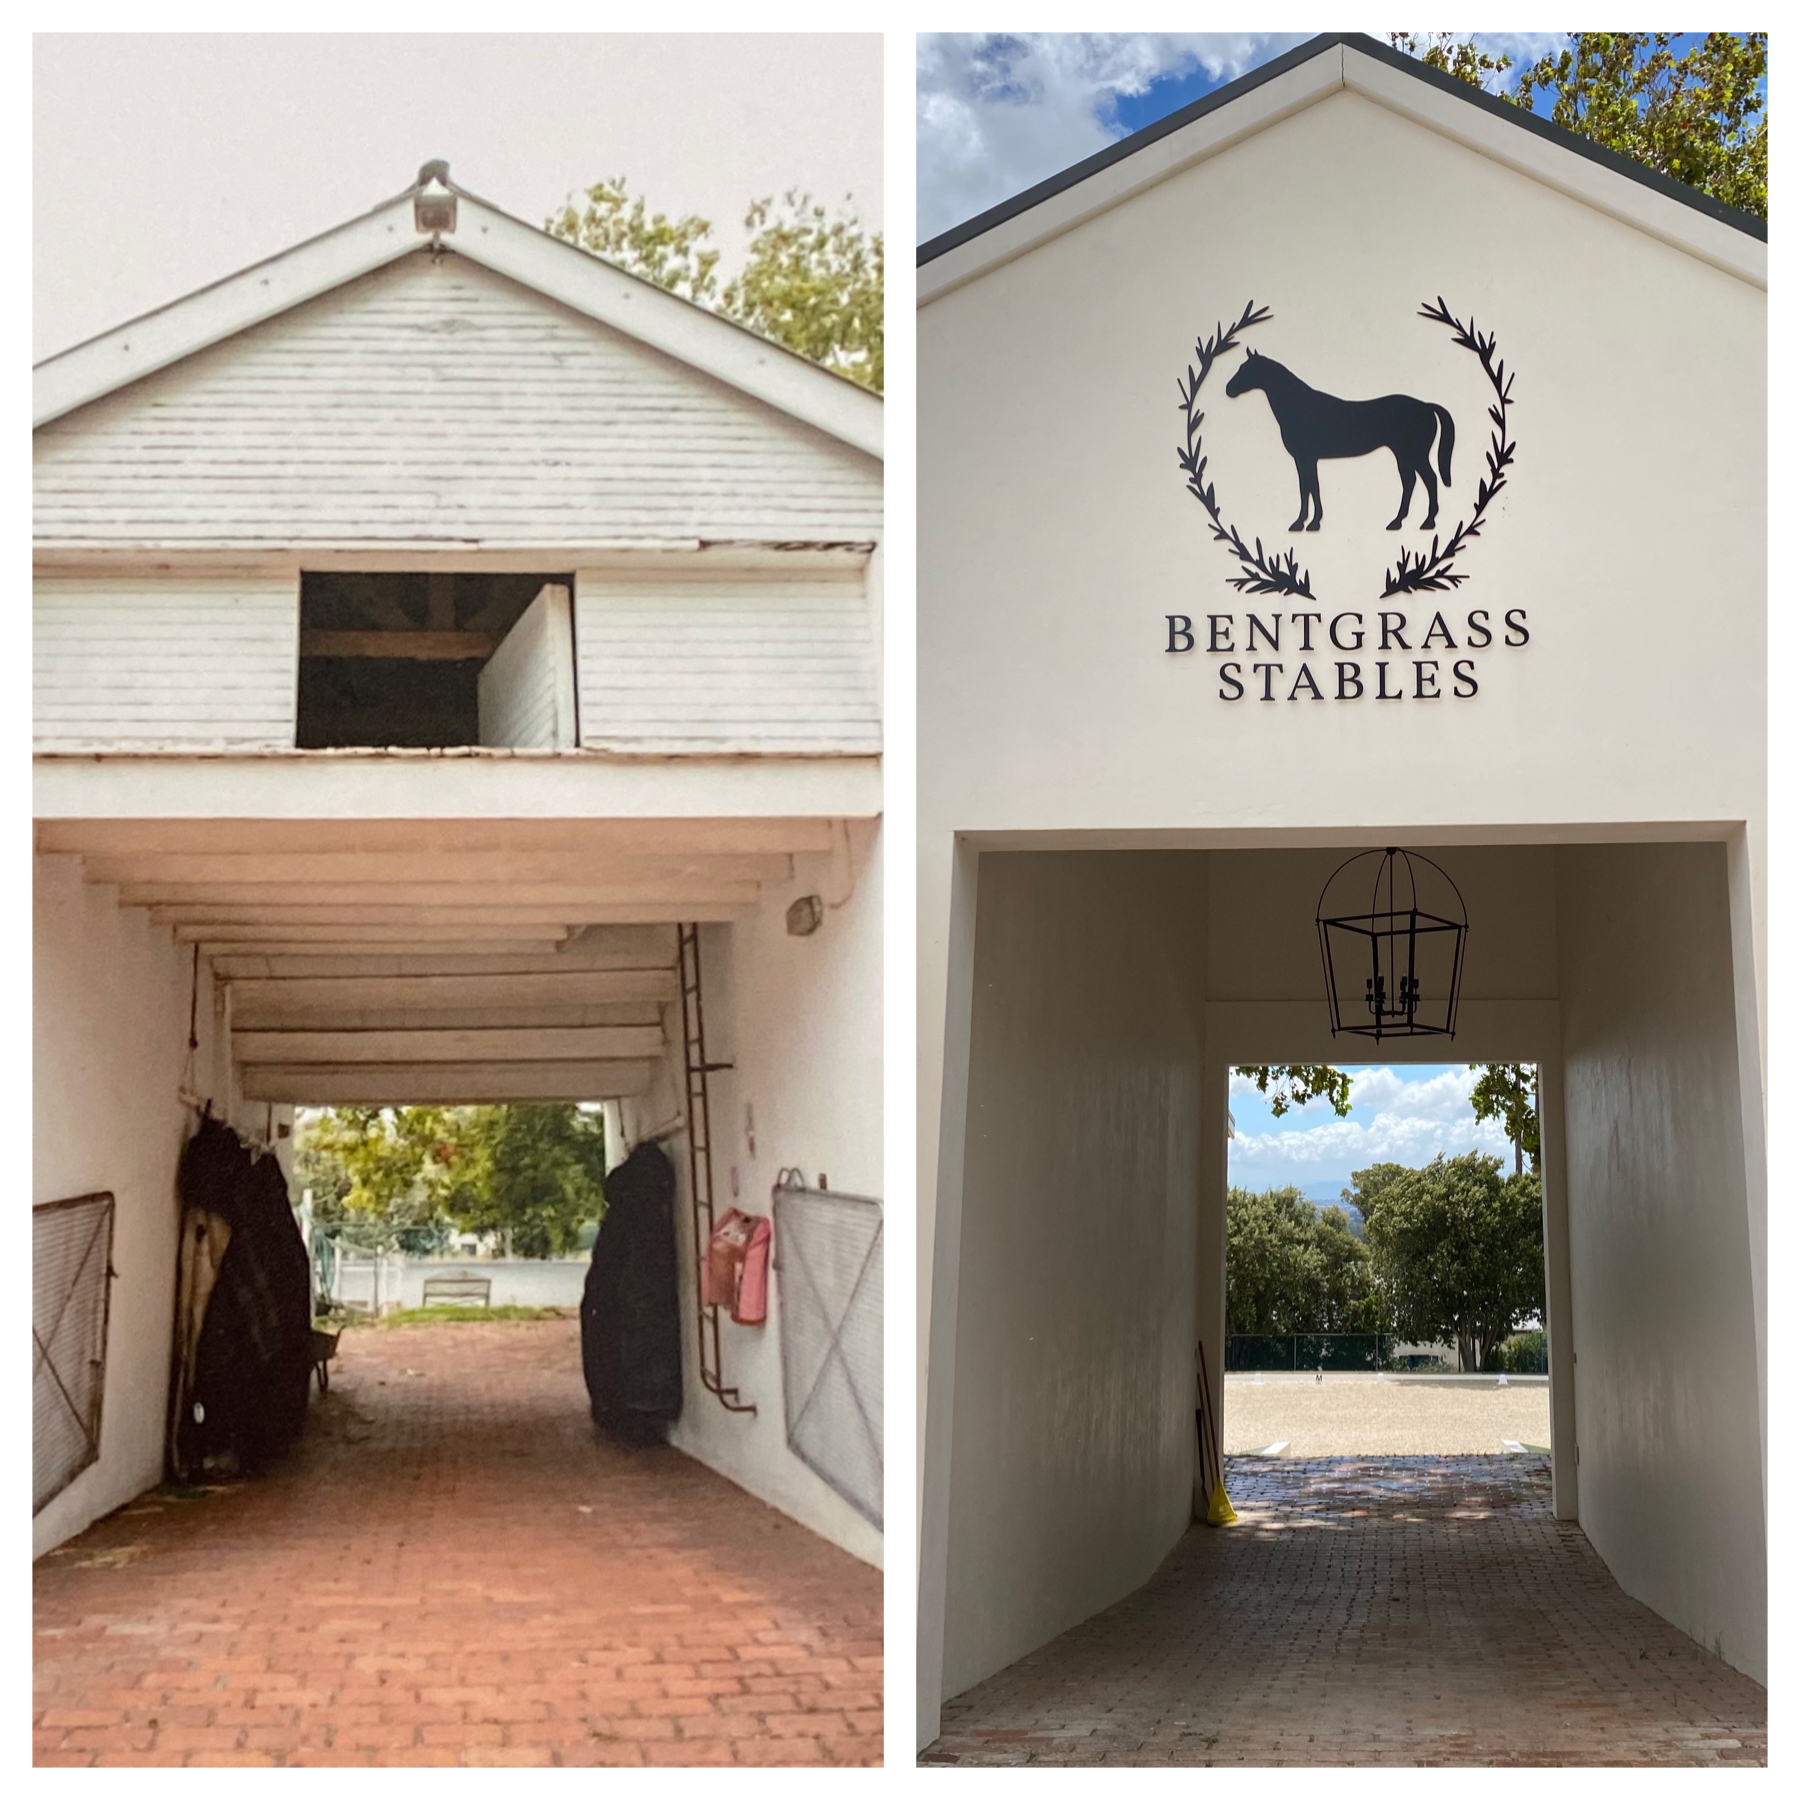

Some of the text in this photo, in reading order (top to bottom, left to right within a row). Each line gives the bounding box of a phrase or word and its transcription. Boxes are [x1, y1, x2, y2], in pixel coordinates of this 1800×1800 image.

[1165, 609, 1530, 652] BENTGRASS
[1219, 660, 1478, 701] STABLES
[1315, 1374, 1323, 1382] M
